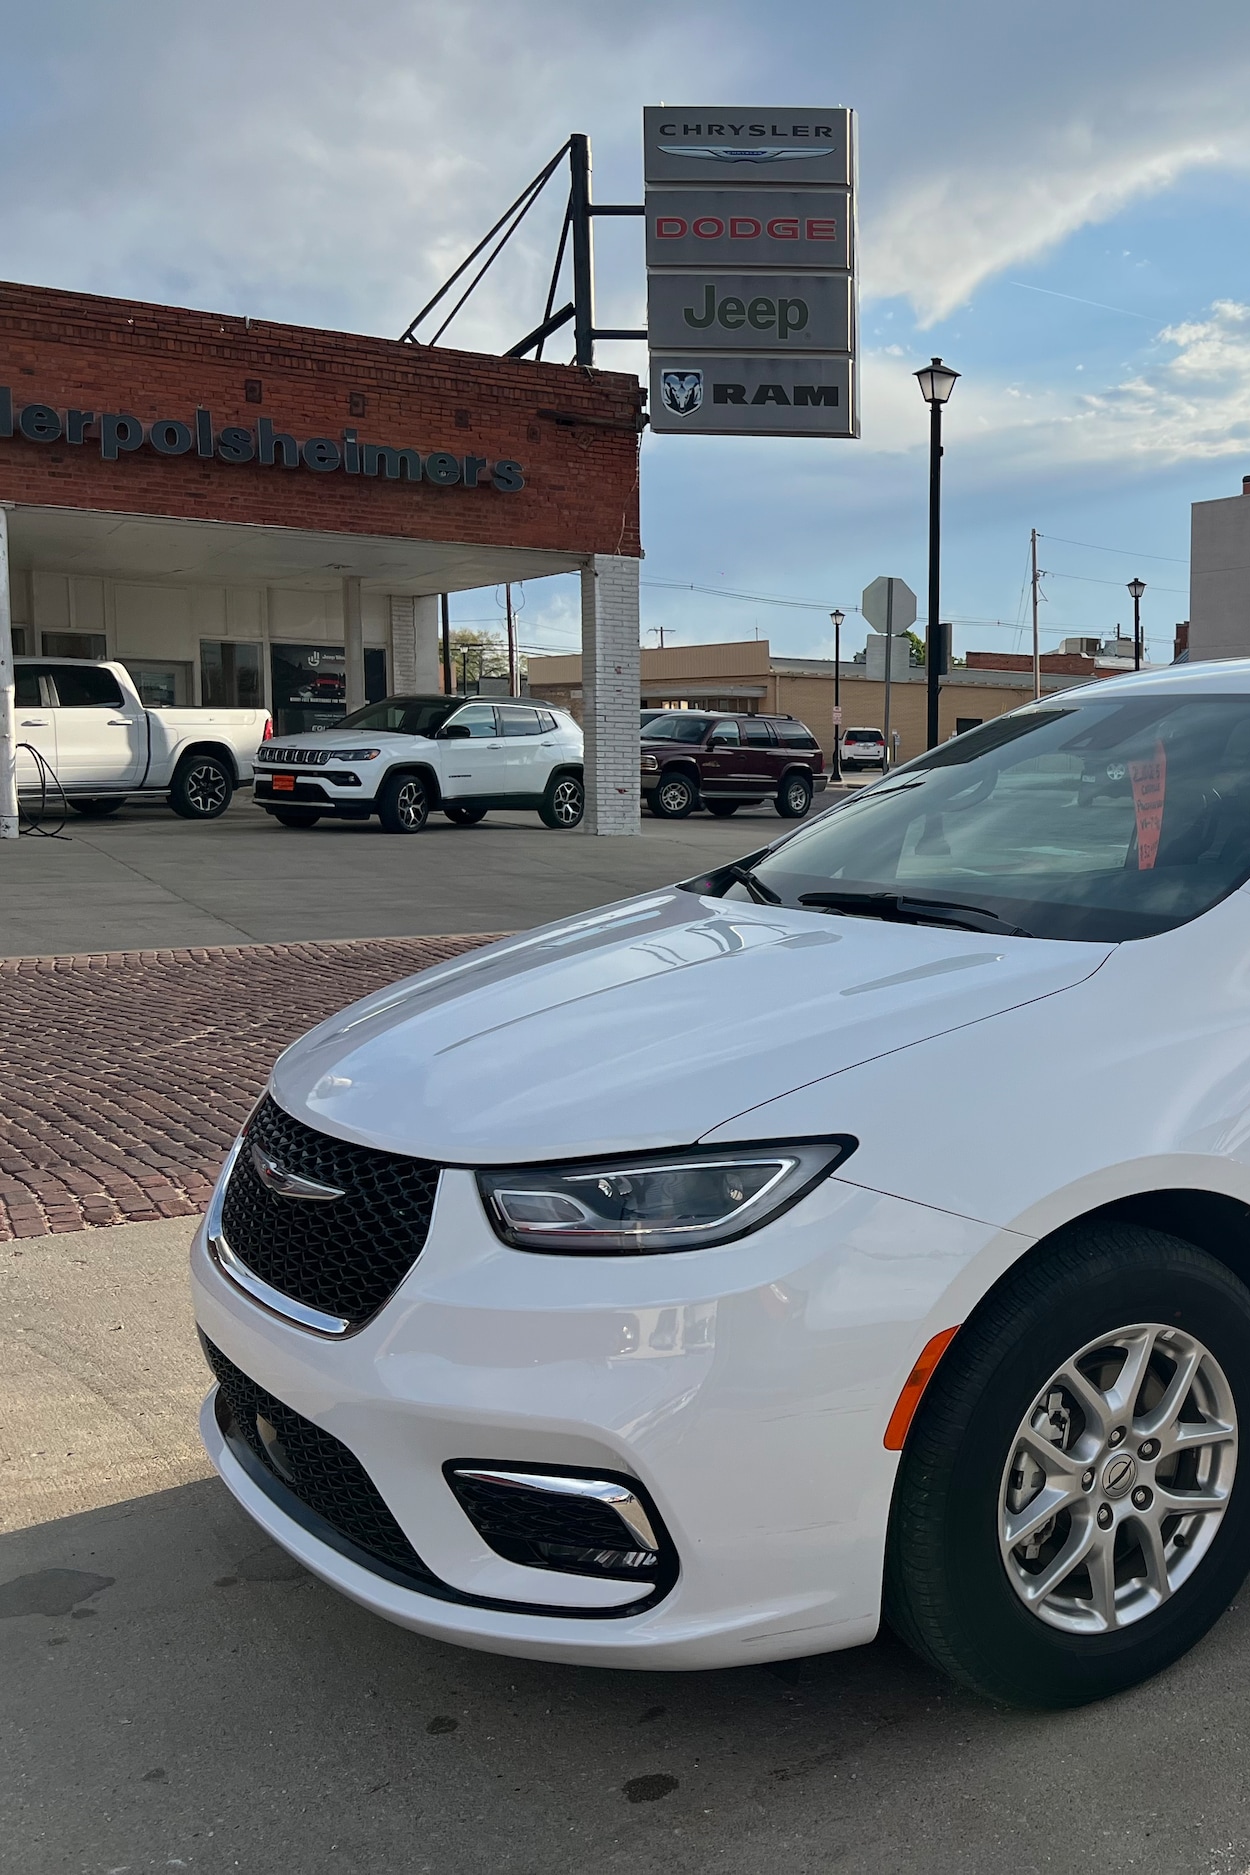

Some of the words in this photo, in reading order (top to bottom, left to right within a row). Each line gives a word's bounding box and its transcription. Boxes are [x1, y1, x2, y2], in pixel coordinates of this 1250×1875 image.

[659, 124, 833, 138] CHRYSLER
[655, 216, 837, 241] DODGE
[683, 284, 809, 340] Jeep
[712, 383, 839, 407] RAM
